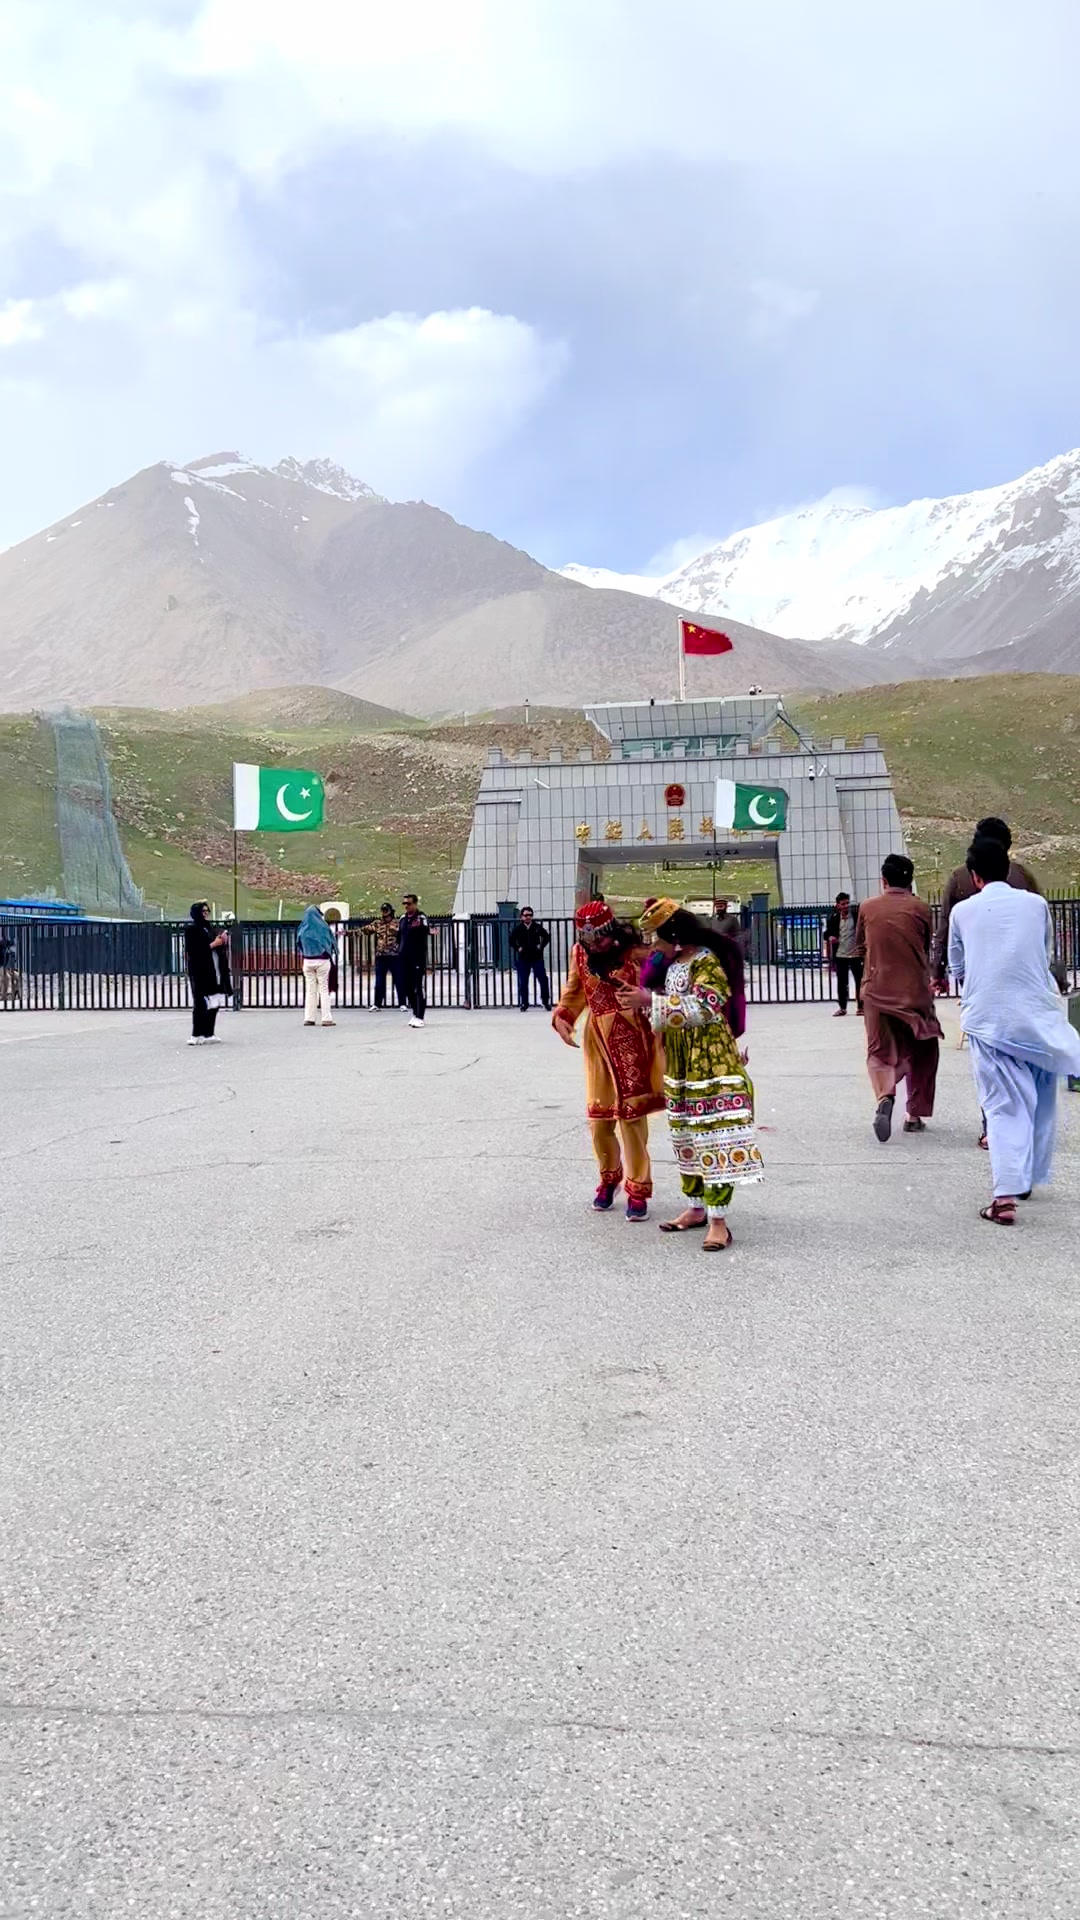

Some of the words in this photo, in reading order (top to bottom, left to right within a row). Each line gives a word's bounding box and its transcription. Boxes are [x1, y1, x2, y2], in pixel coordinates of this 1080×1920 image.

[576, 816, 781, 845] 中华人民共
